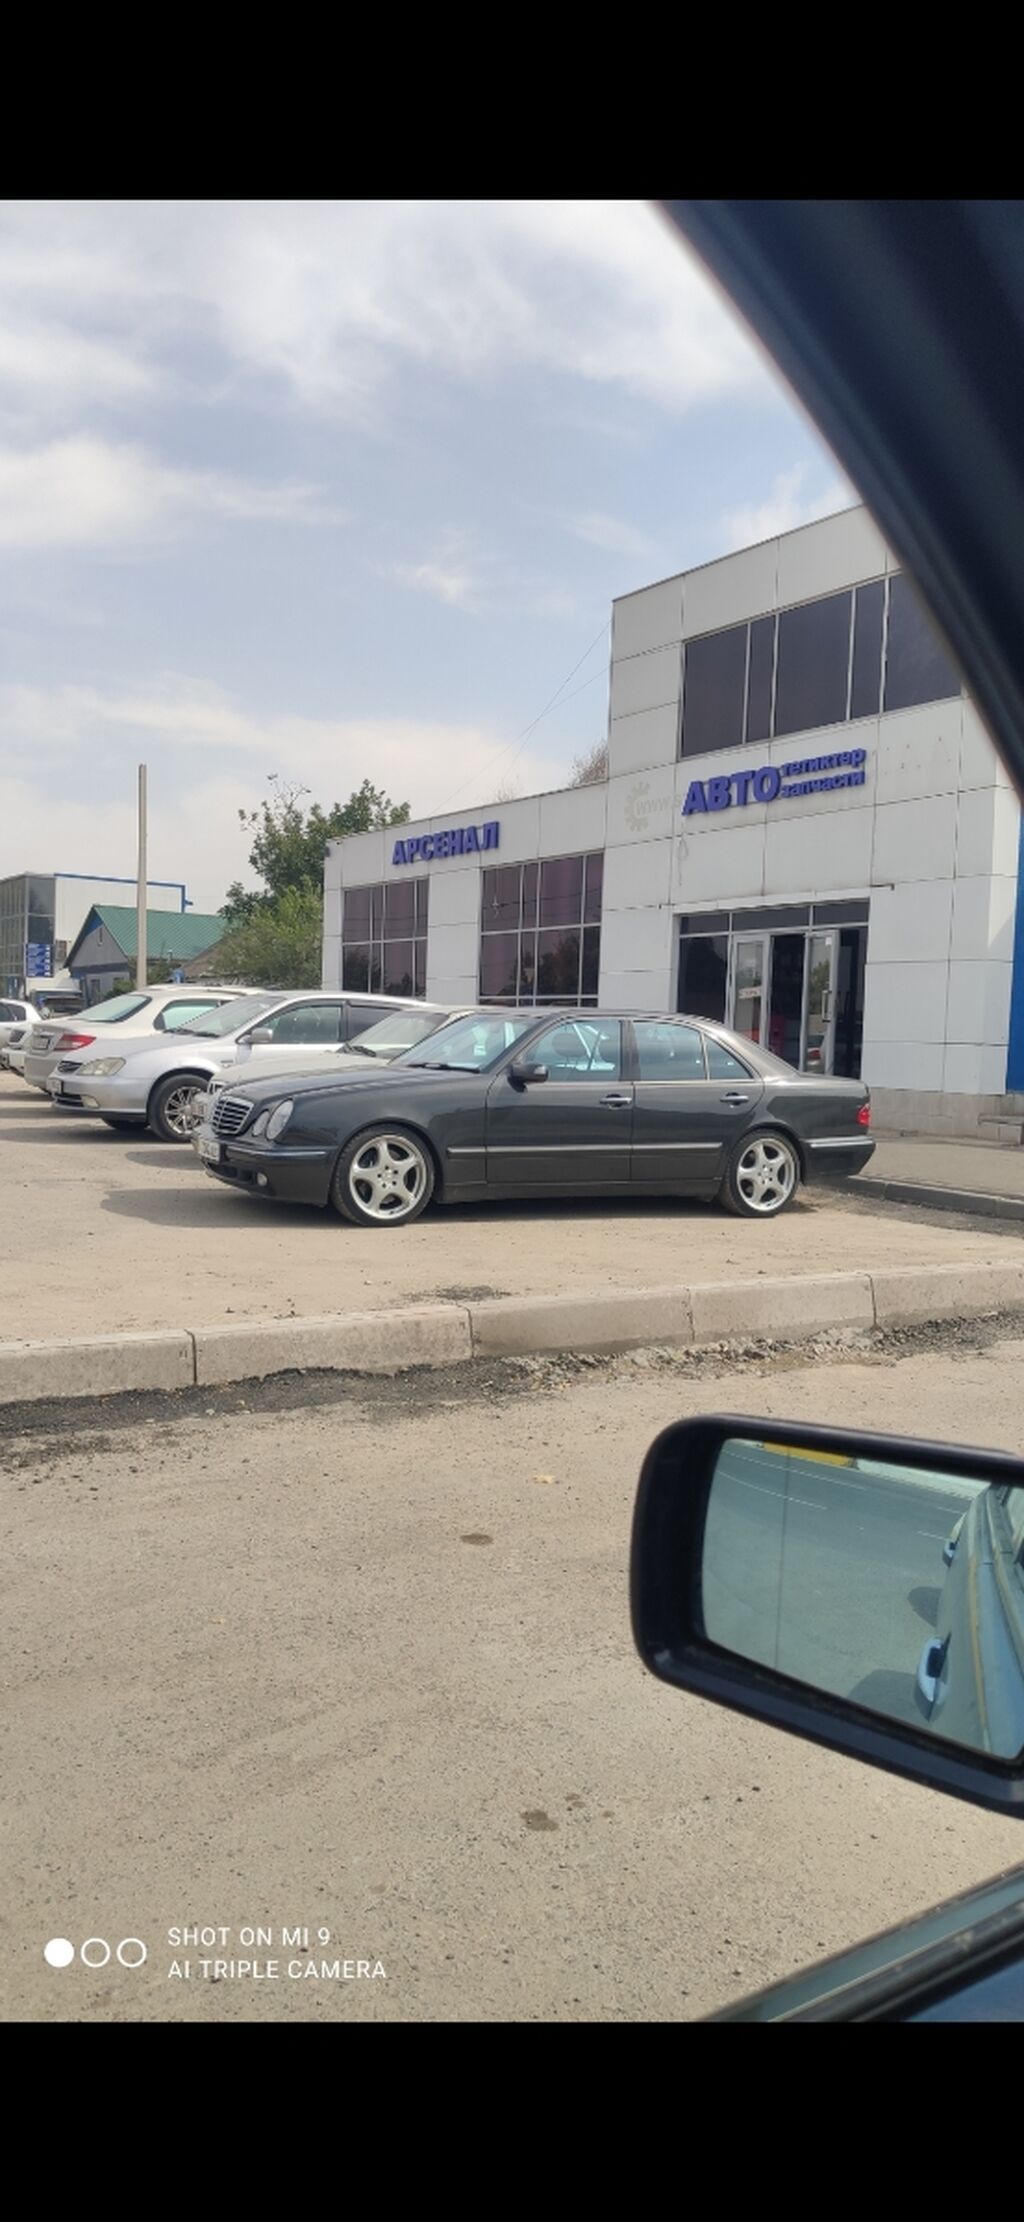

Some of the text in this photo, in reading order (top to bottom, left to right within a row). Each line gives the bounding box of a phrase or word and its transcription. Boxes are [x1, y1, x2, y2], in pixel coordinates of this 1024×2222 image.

[780, 748, 866, 777] тетиктер
[682, 766, 780, 816] АВТО
[781, 770, 865, 798] запчасти
[392, 821, 500, 865] АРСЕНАЛ
